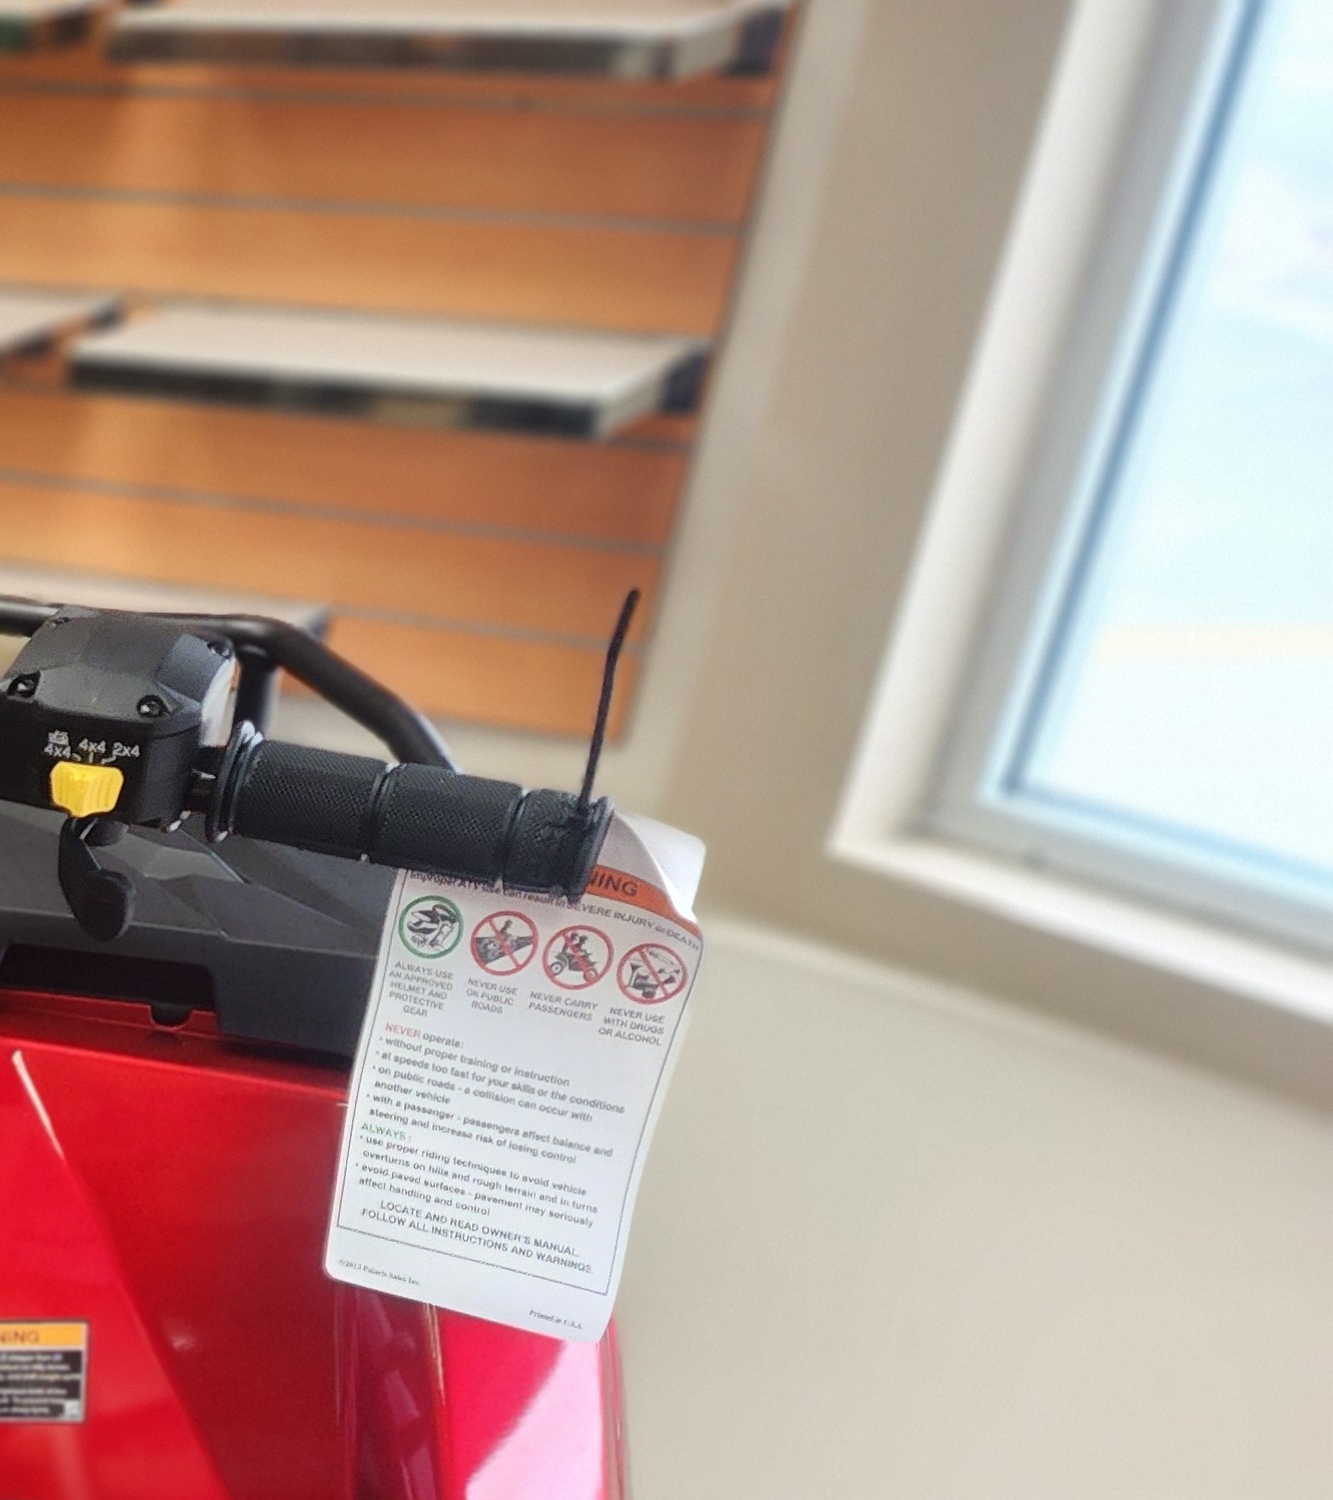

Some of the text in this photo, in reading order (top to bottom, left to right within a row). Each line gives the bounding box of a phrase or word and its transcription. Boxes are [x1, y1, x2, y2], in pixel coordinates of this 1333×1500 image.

[44, 743, 71, 758] 4x4
[78, 738, 106, 753] 4x4
[113, 742, 140, 757] 2x4
[395, 959, 454, 980] ALWAYS USE
[465, 987, 514, 1006] ON PUBLIC
[467, 977, 518, 995] NEVER USE
[388, 990, 444, 1009] PROTECTIVE
[402, 1004, 428, 1017] GEAR
[471, 999, 503, 1014] ROADS
[528, 999, 592, 1022] PASSENGERS
[529, 989, 598, 1012] NEVER CARRY
[603, 1015, 664, 1036] WITH DRUGS
[609, 1005, 665, 1024] NEVER USE
[384, 1022, 465, 1050] NEVER operate:
[598, 1026, 662, 1047] OR ALCOHOL
[385, 1036, 570, 1087] without proper training or instruction
[374, 1079, 451, 1104] another vehicle
[381, 1050, 625, 1114] at speeds too fast for your skills or the conditions
[377, 1066, 390, 1075] on
[393, 1069, 425, 1084] public
[426, 1077, 455, 1090] roads
[472, 1087, 515, 1105] collision
[517, 1099, 536, 1109] can
[539, 1104, 568, 1116] occur
[570, 1110, 593, 1122] with
[368, 1107, 576, 1163] steering and increase risk of losing control
[372, 1094, 393, 1105] with
[403, 1102, 454, 1121] passenger
[462, 1115, 519, 1137] passengers
[522, 1128, 551, 1143] affect
[552, 1135, 591, 1152] balance
[593, 1145, 613, 1157] and
[365, 1136, 587, 1196] use proper riding techniques to avoid vehicle
[362, 1150, 598, 1214] overturns on hills and rough terrain and in turns
[358, 1176, 490, 1215] affect handling and control
[361, 1163, 593, 1228] avoid paved surfaces pavement may seriously
[361, 1208, 533, 1258] FOLLOW ALL INSTRUCTIONS AND
[379, 1200, 422, 1218] LOCATE
[424, 1211, 447, 1224] AND
[449, 1217, 479, 1231] READ
[481, 1225, 531, 1245] OWNER'S
